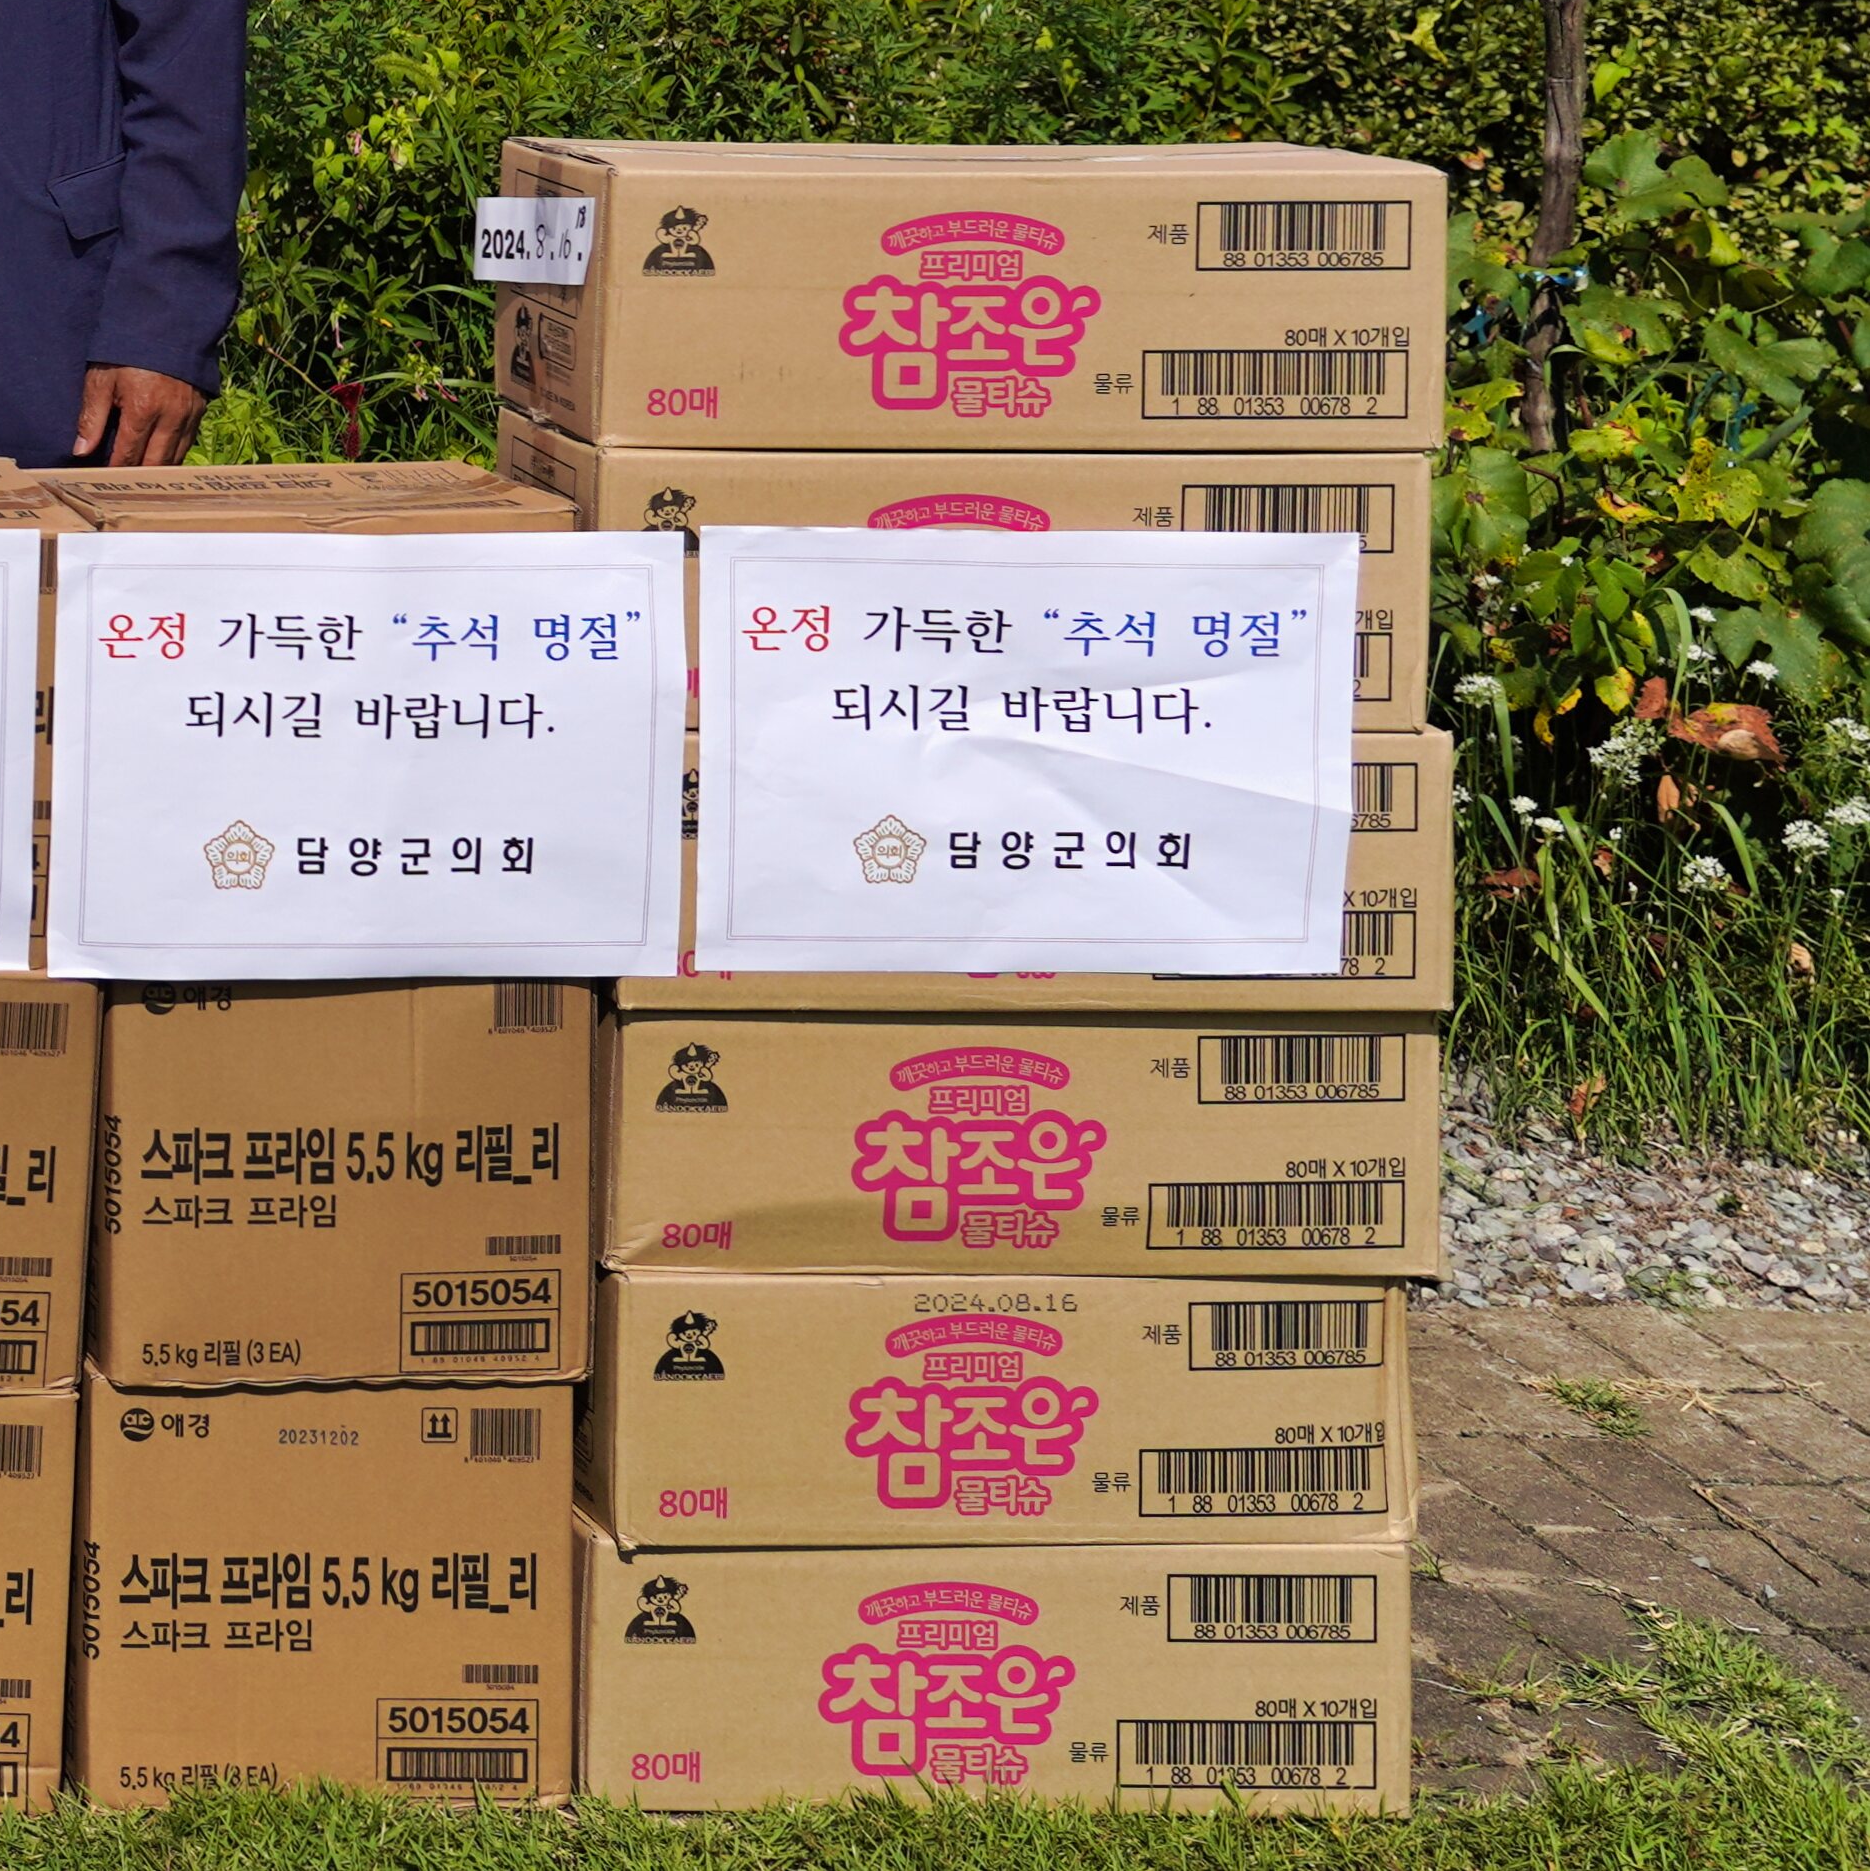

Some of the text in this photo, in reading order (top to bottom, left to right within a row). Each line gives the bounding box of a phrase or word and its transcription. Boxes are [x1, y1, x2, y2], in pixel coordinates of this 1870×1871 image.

[482, 229, 530, 260] 2024.
[844, 281, 1096, 404] 참조은
[647, 386, 718, 419] 80매
[949, 374, 1052, 418] 물티슈
[99, 611, 640, 662] 온정 가득한 “추석 명절”
[742, 605, 1307, 658] 온정 가득한 “추석 명절”
[186, 691, 554, 740] 되시길 바랍니다.
[832, 684, 1211, 735] 되시길 바랍니다.
[297, 837, 533, 877] 담양군의회
[949, 831, 1191, 870] 담양군의회
[141, 1127, 234, 1185] 스파크
[244, 1128, 335, 1185] 프라임
[857, 1114, 1103, 1237] 참조은
[413, 1278, 551, 1307] 5015054
[915, 1293, 1078, 1316] 2024.08.16
[120, 1553, 211, 1610] 스파크
[221, 1552, 310, 1609] 프라임
[389, 1707, 529, 1734] 5015054
